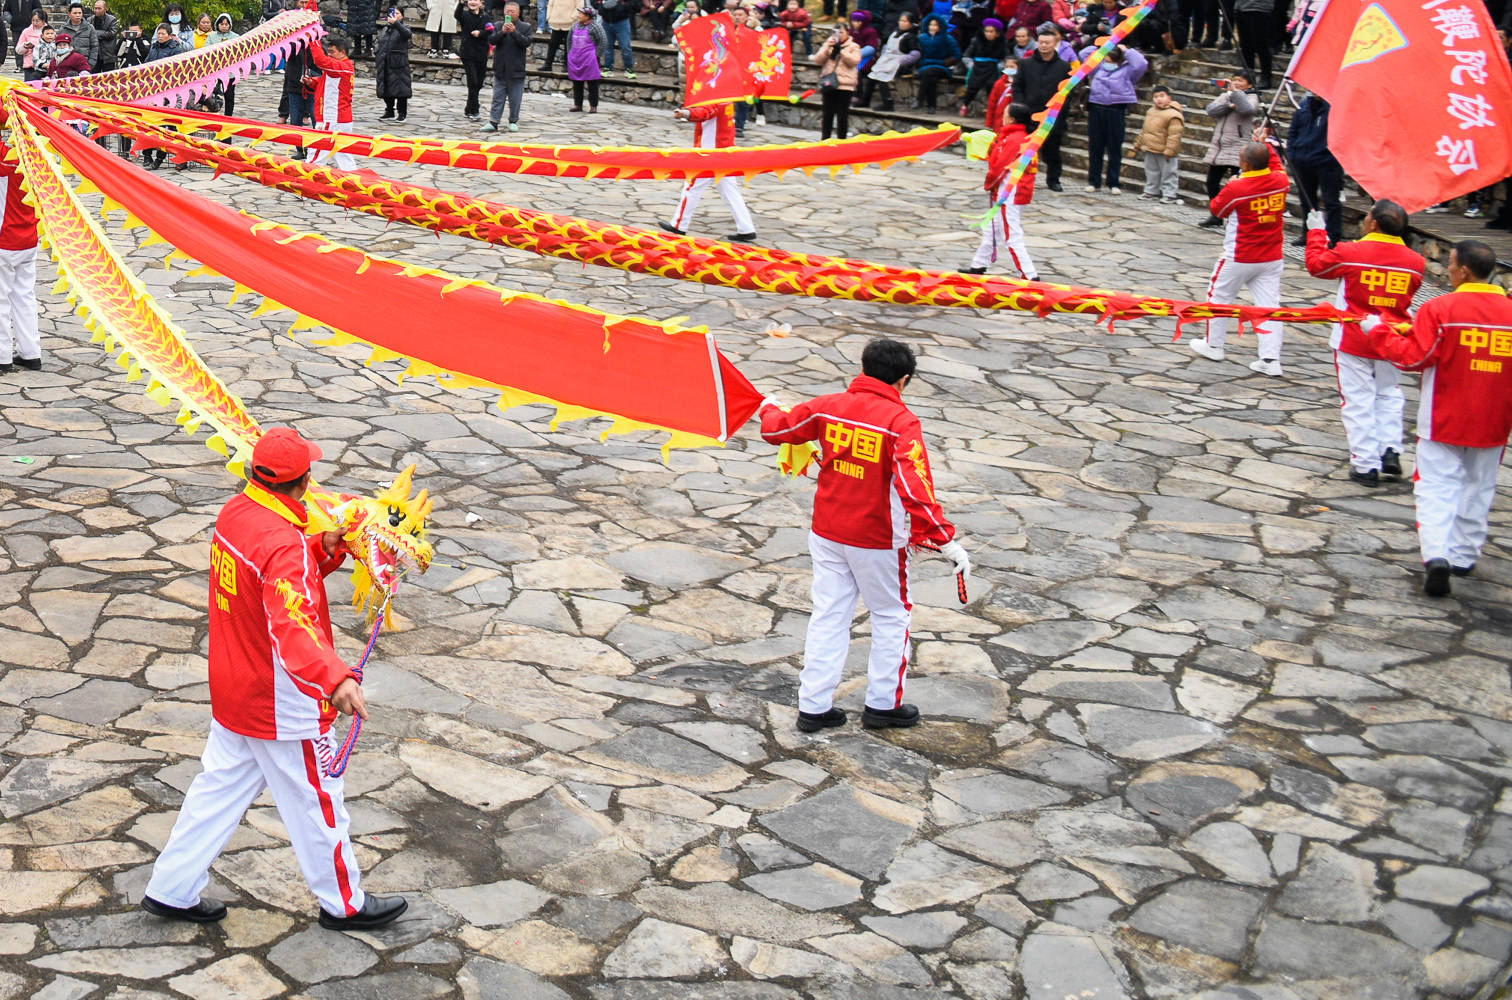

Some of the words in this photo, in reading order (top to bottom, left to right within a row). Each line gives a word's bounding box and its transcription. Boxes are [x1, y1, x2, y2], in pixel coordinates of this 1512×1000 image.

[1250, 192, 1286, 214] 中国
[1360, 269, 1412, 295] 中国
[1459, 327, 1512, 357] 中国
[825, 422, 883, 463] 中国
[833, 459, 865, 480] CHINA
[211, 542, 237, 596] 中国
